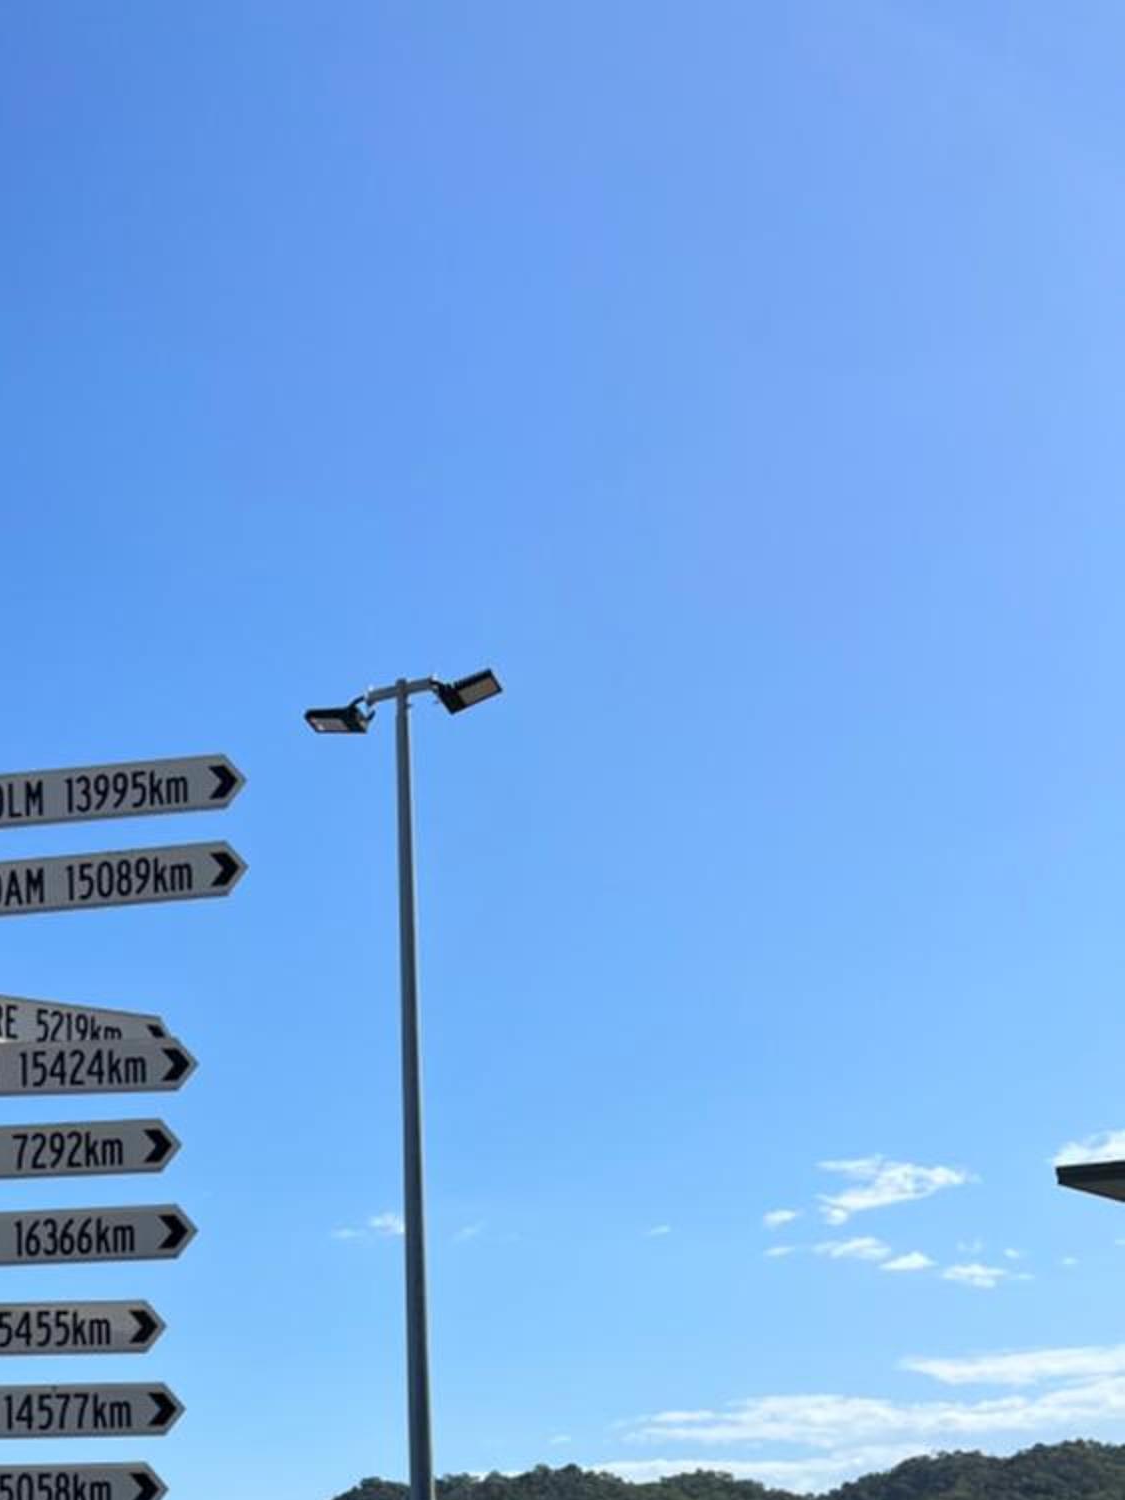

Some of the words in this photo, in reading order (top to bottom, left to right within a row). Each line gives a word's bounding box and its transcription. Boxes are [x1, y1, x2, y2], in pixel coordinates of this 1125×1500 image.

[66, 770, 189, 814] 13995km
[66, 857, 193, 901] 15089km
[36, 1008, 122, 1042] 5219km
[20, 1049, 147, 1087] 15424km
[13, 1131, 123, 1170] 7292km
[15, 1218, 135, 1257] 16366km
[5, 1392, 132, 1431] 14577km
